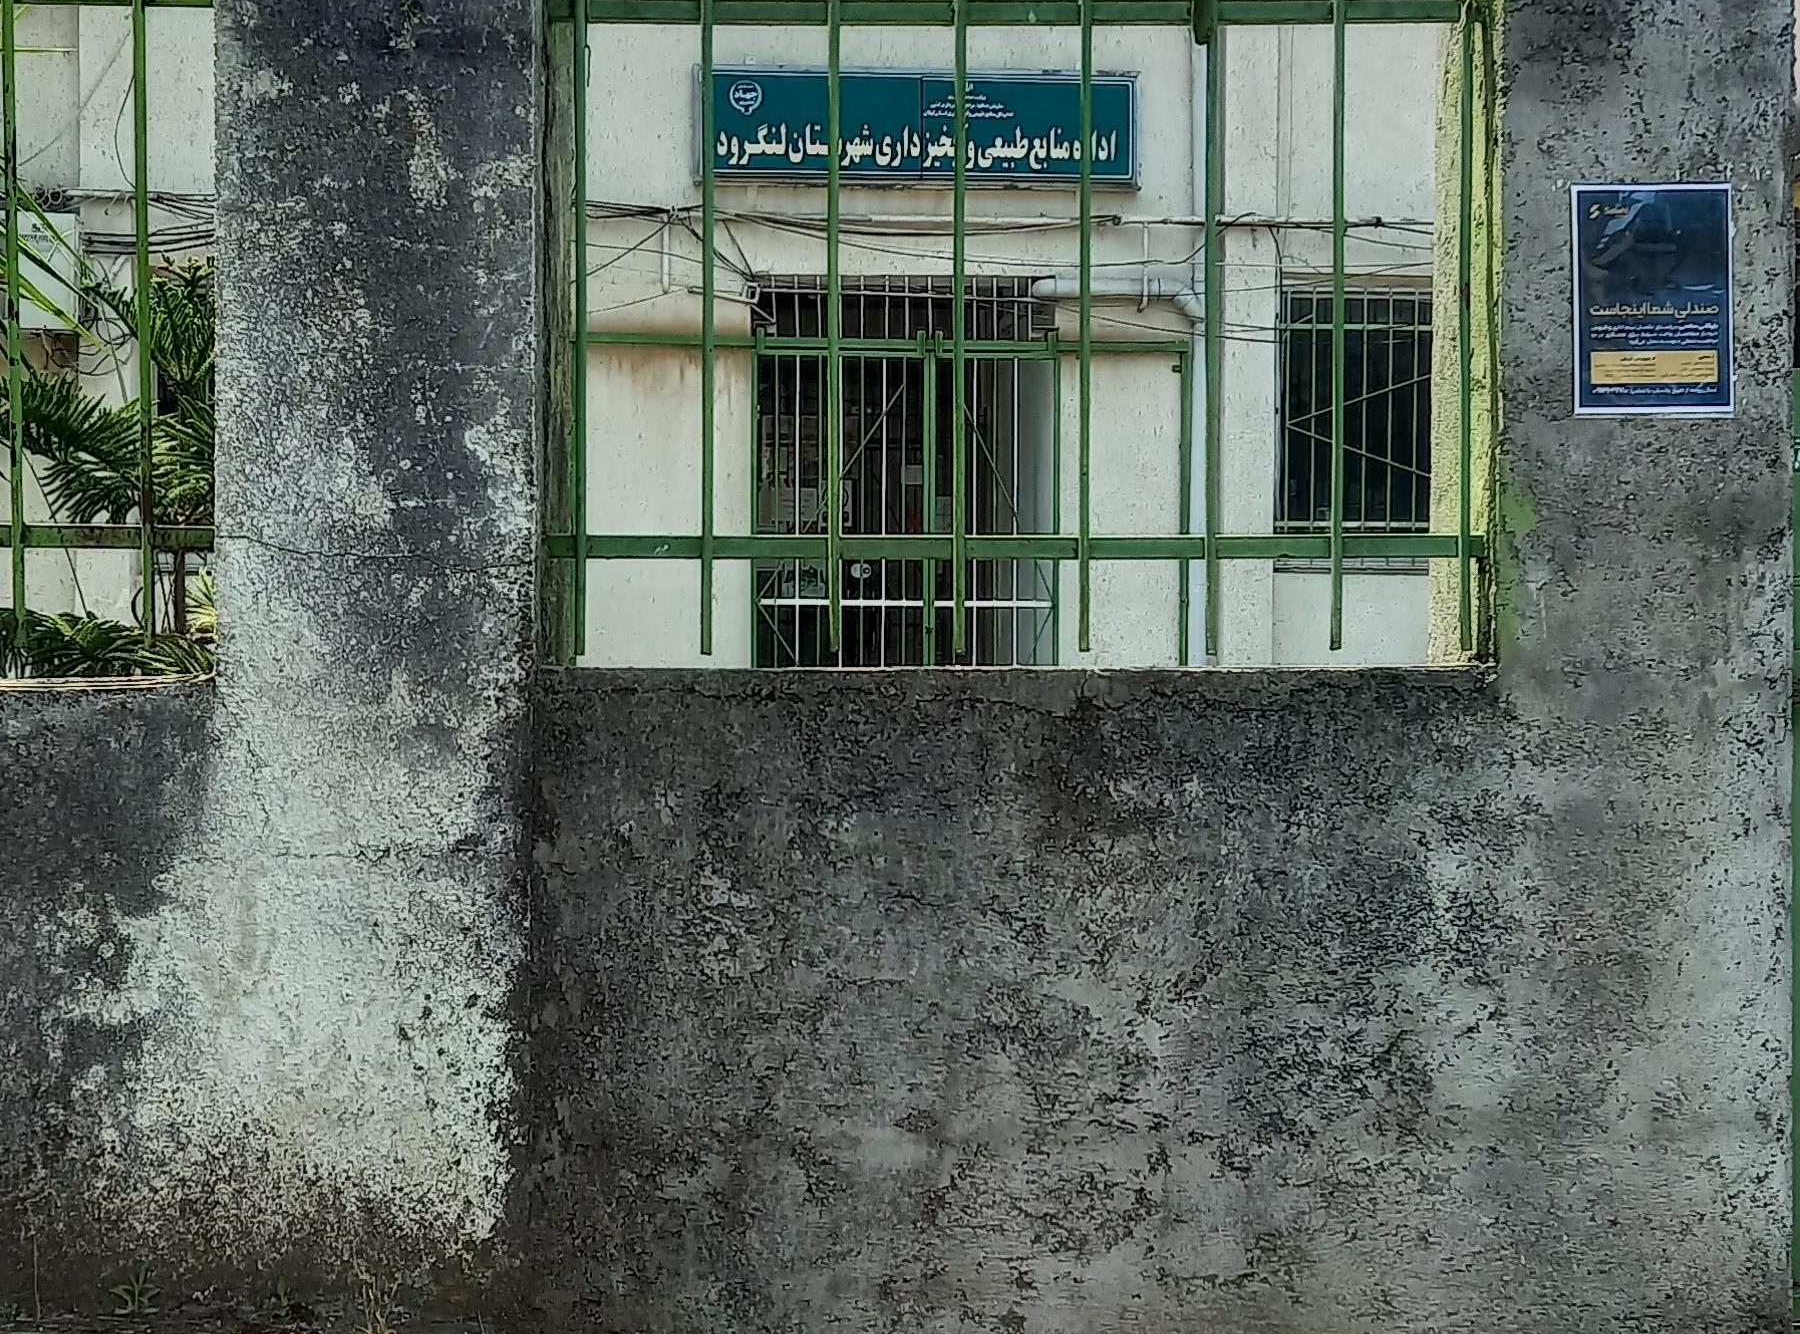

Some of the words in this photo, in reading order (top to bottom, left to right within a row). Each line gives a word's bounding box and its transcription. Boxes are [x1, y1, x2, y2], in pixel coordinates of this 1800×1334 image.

[716, 122, 788, 166] لنگرود
[964, 140, 975, 169] و
[977, 126, 1029, 169] طبیعی
[1029, 126, 1071, 170] منابع
[1073, 129, 1117, 161] اداه
[1589, 301, 1647, 318] اینجاست
[1647, 300, 1675, 315] شما
